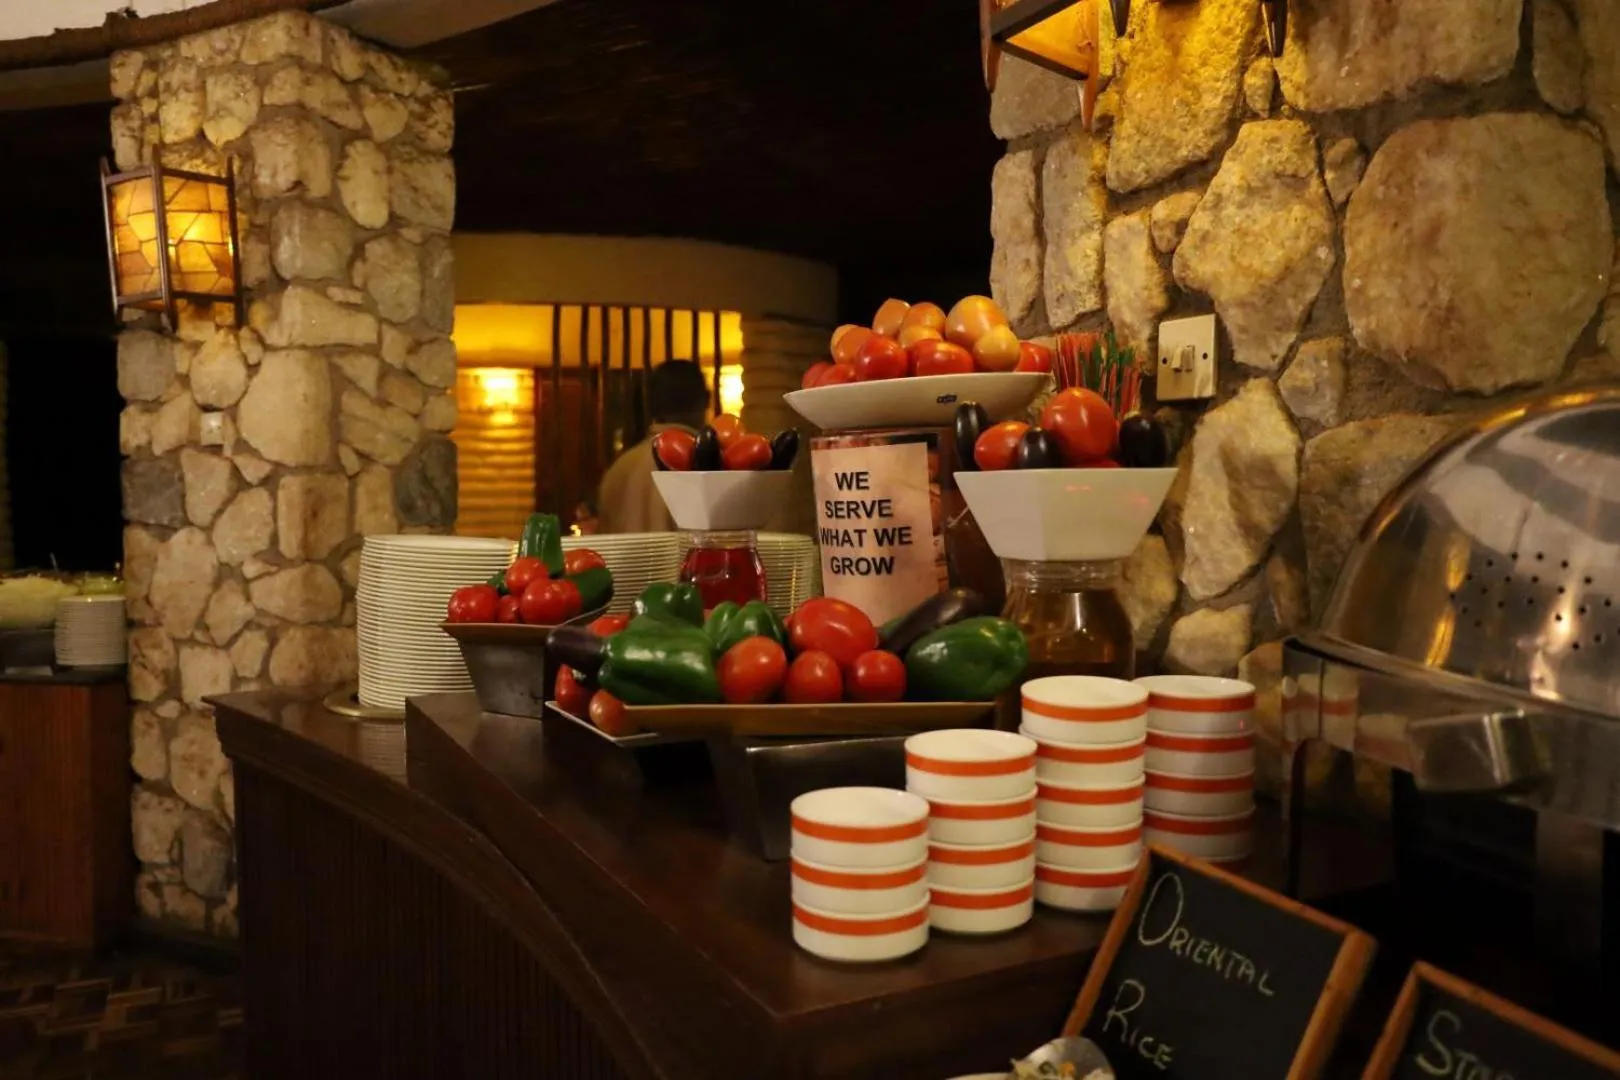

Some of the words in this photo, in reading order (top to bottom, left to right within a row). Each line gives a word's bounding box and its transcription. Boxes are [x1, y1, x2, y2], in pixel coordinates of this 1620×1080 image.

[835, 471, 870, 491] WE
[825, 499, 894, 519] SERVE
[820, 527, 867, 547] WHAT
[873, 526, 913, 547] WE
[830, 556, 895, 576] GROW
[1137, 872, 1275, 997] ORIENTAL
[1102, 978, 1175, 1070] RICE
